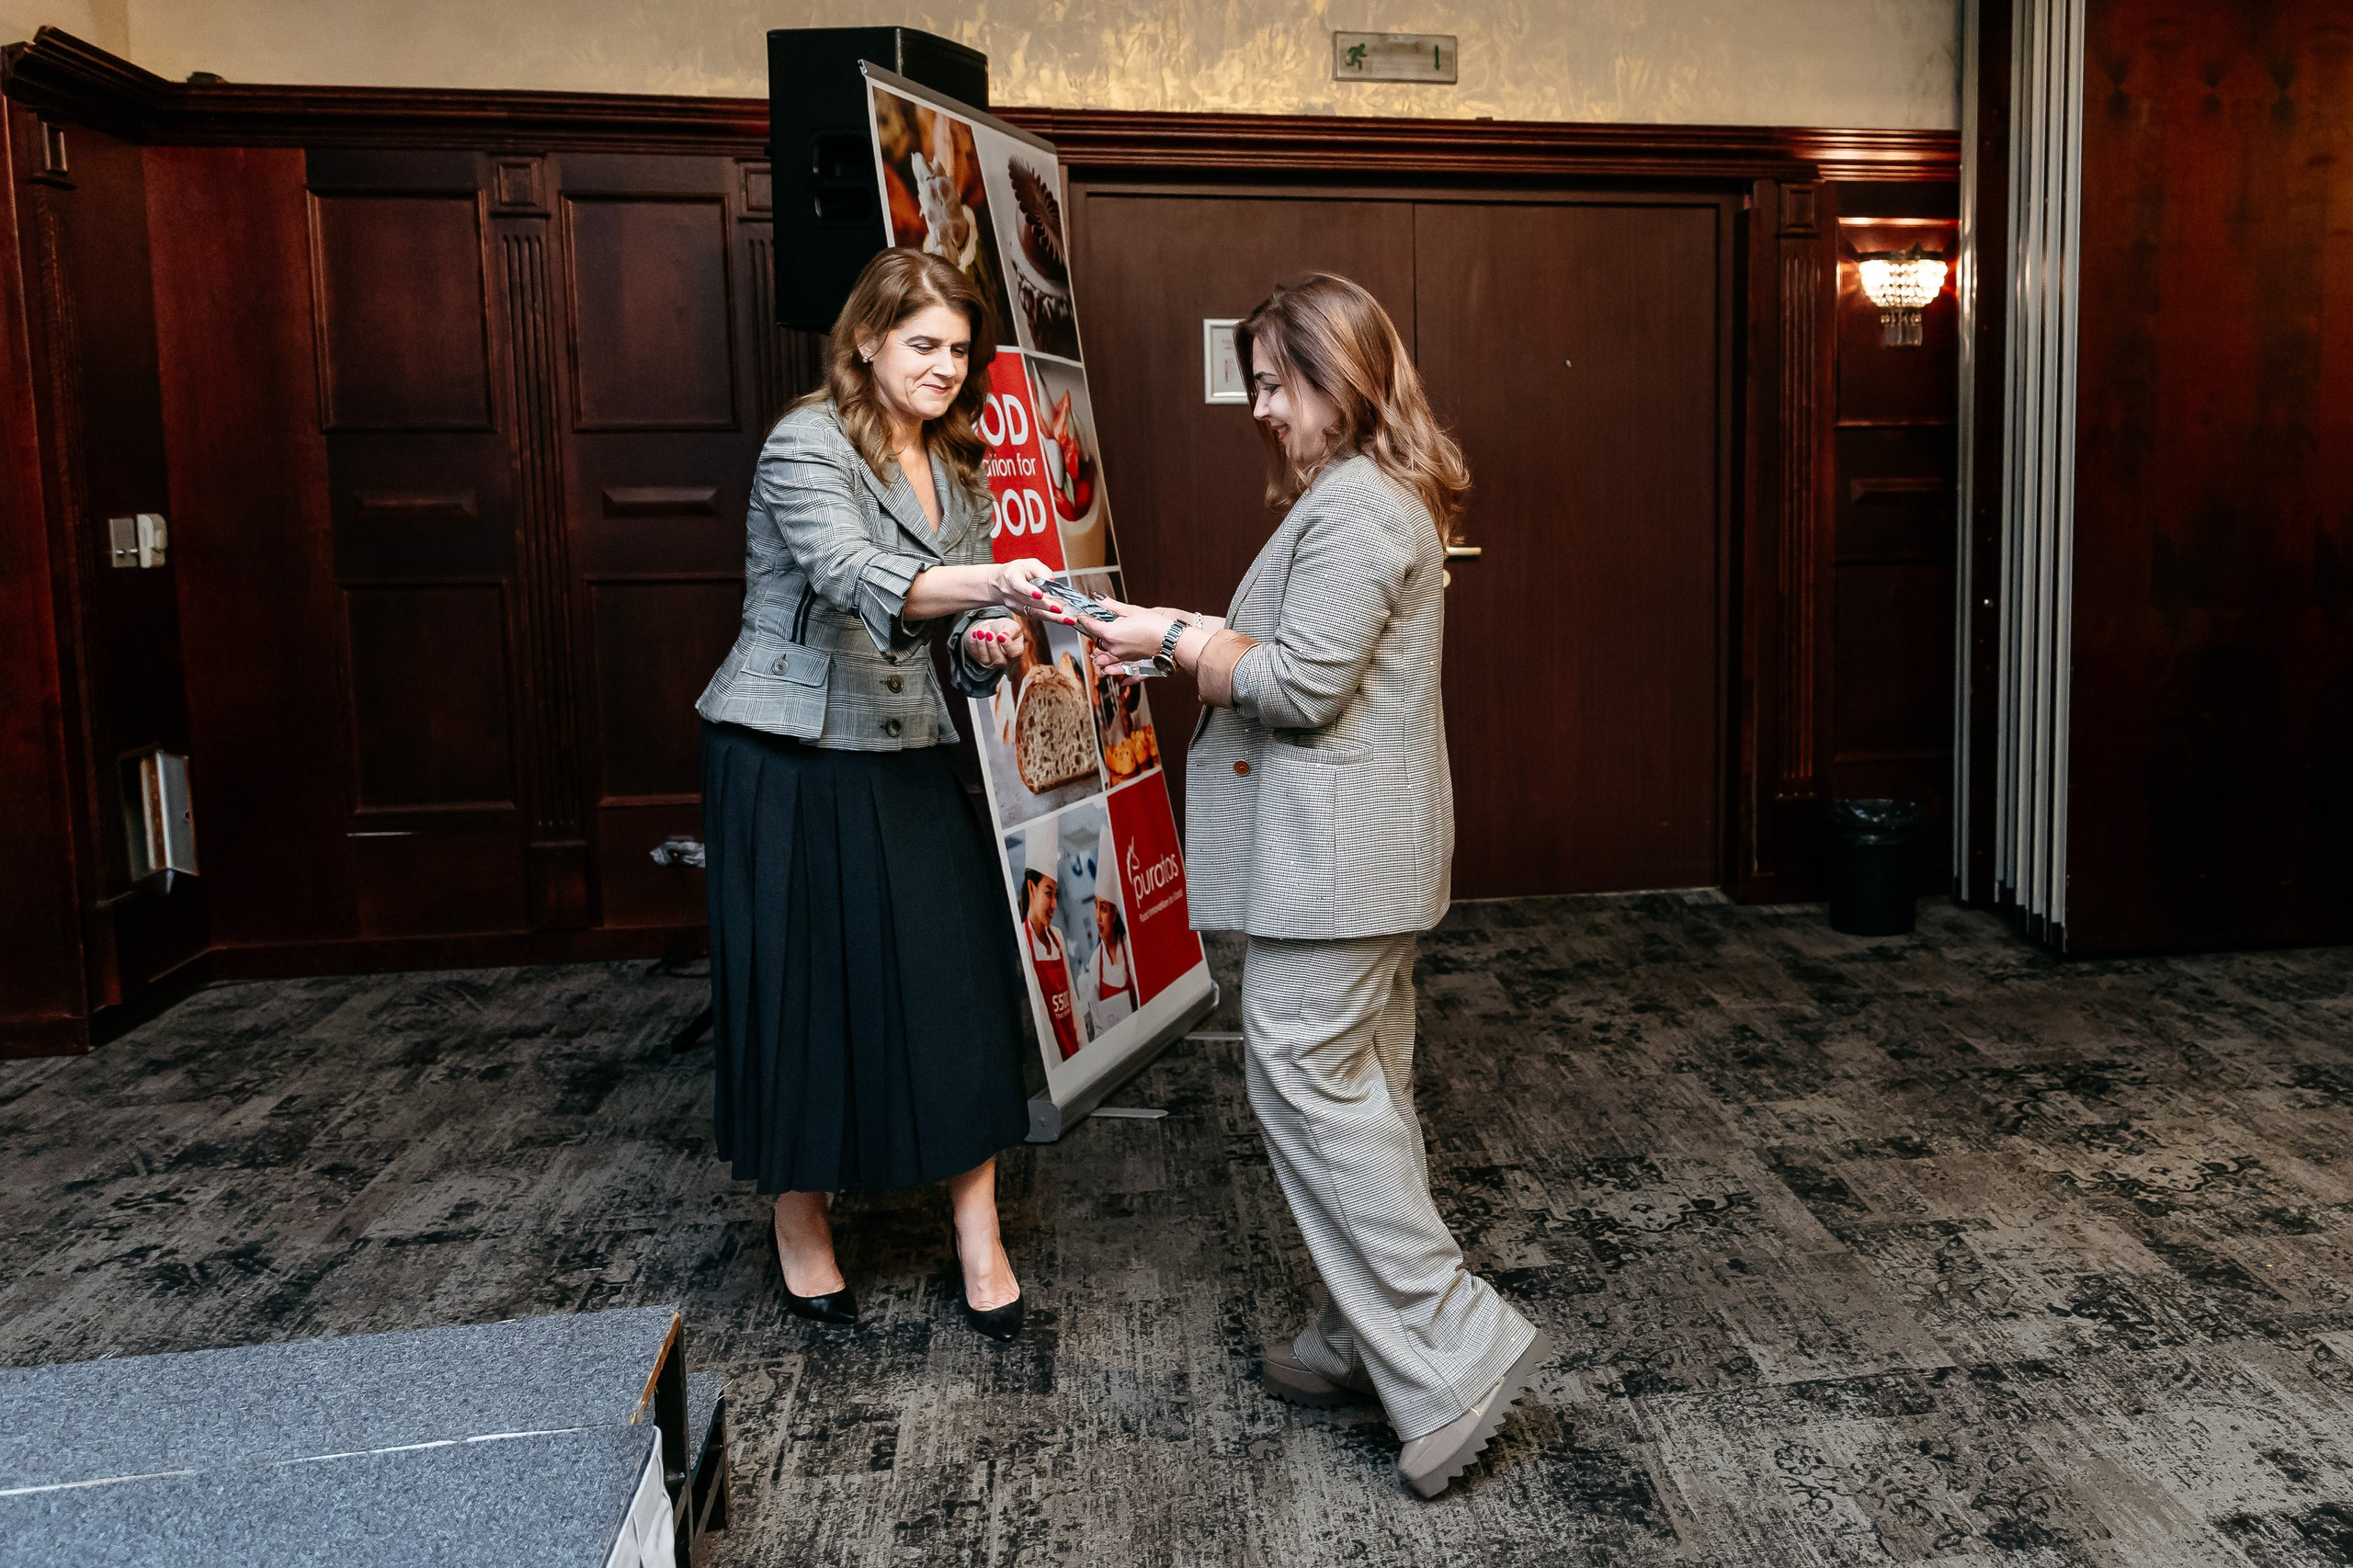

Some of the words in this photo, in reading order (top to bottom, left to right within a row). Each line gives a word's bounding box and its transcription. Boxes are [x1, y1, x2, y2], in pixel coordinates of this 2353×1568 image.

[972, 392, 1029, 447] OD
[982, 453, 1017, 477] ation
[1016, 452, 1037, 476] for
[1132, 853, 1179, 909] puratos
